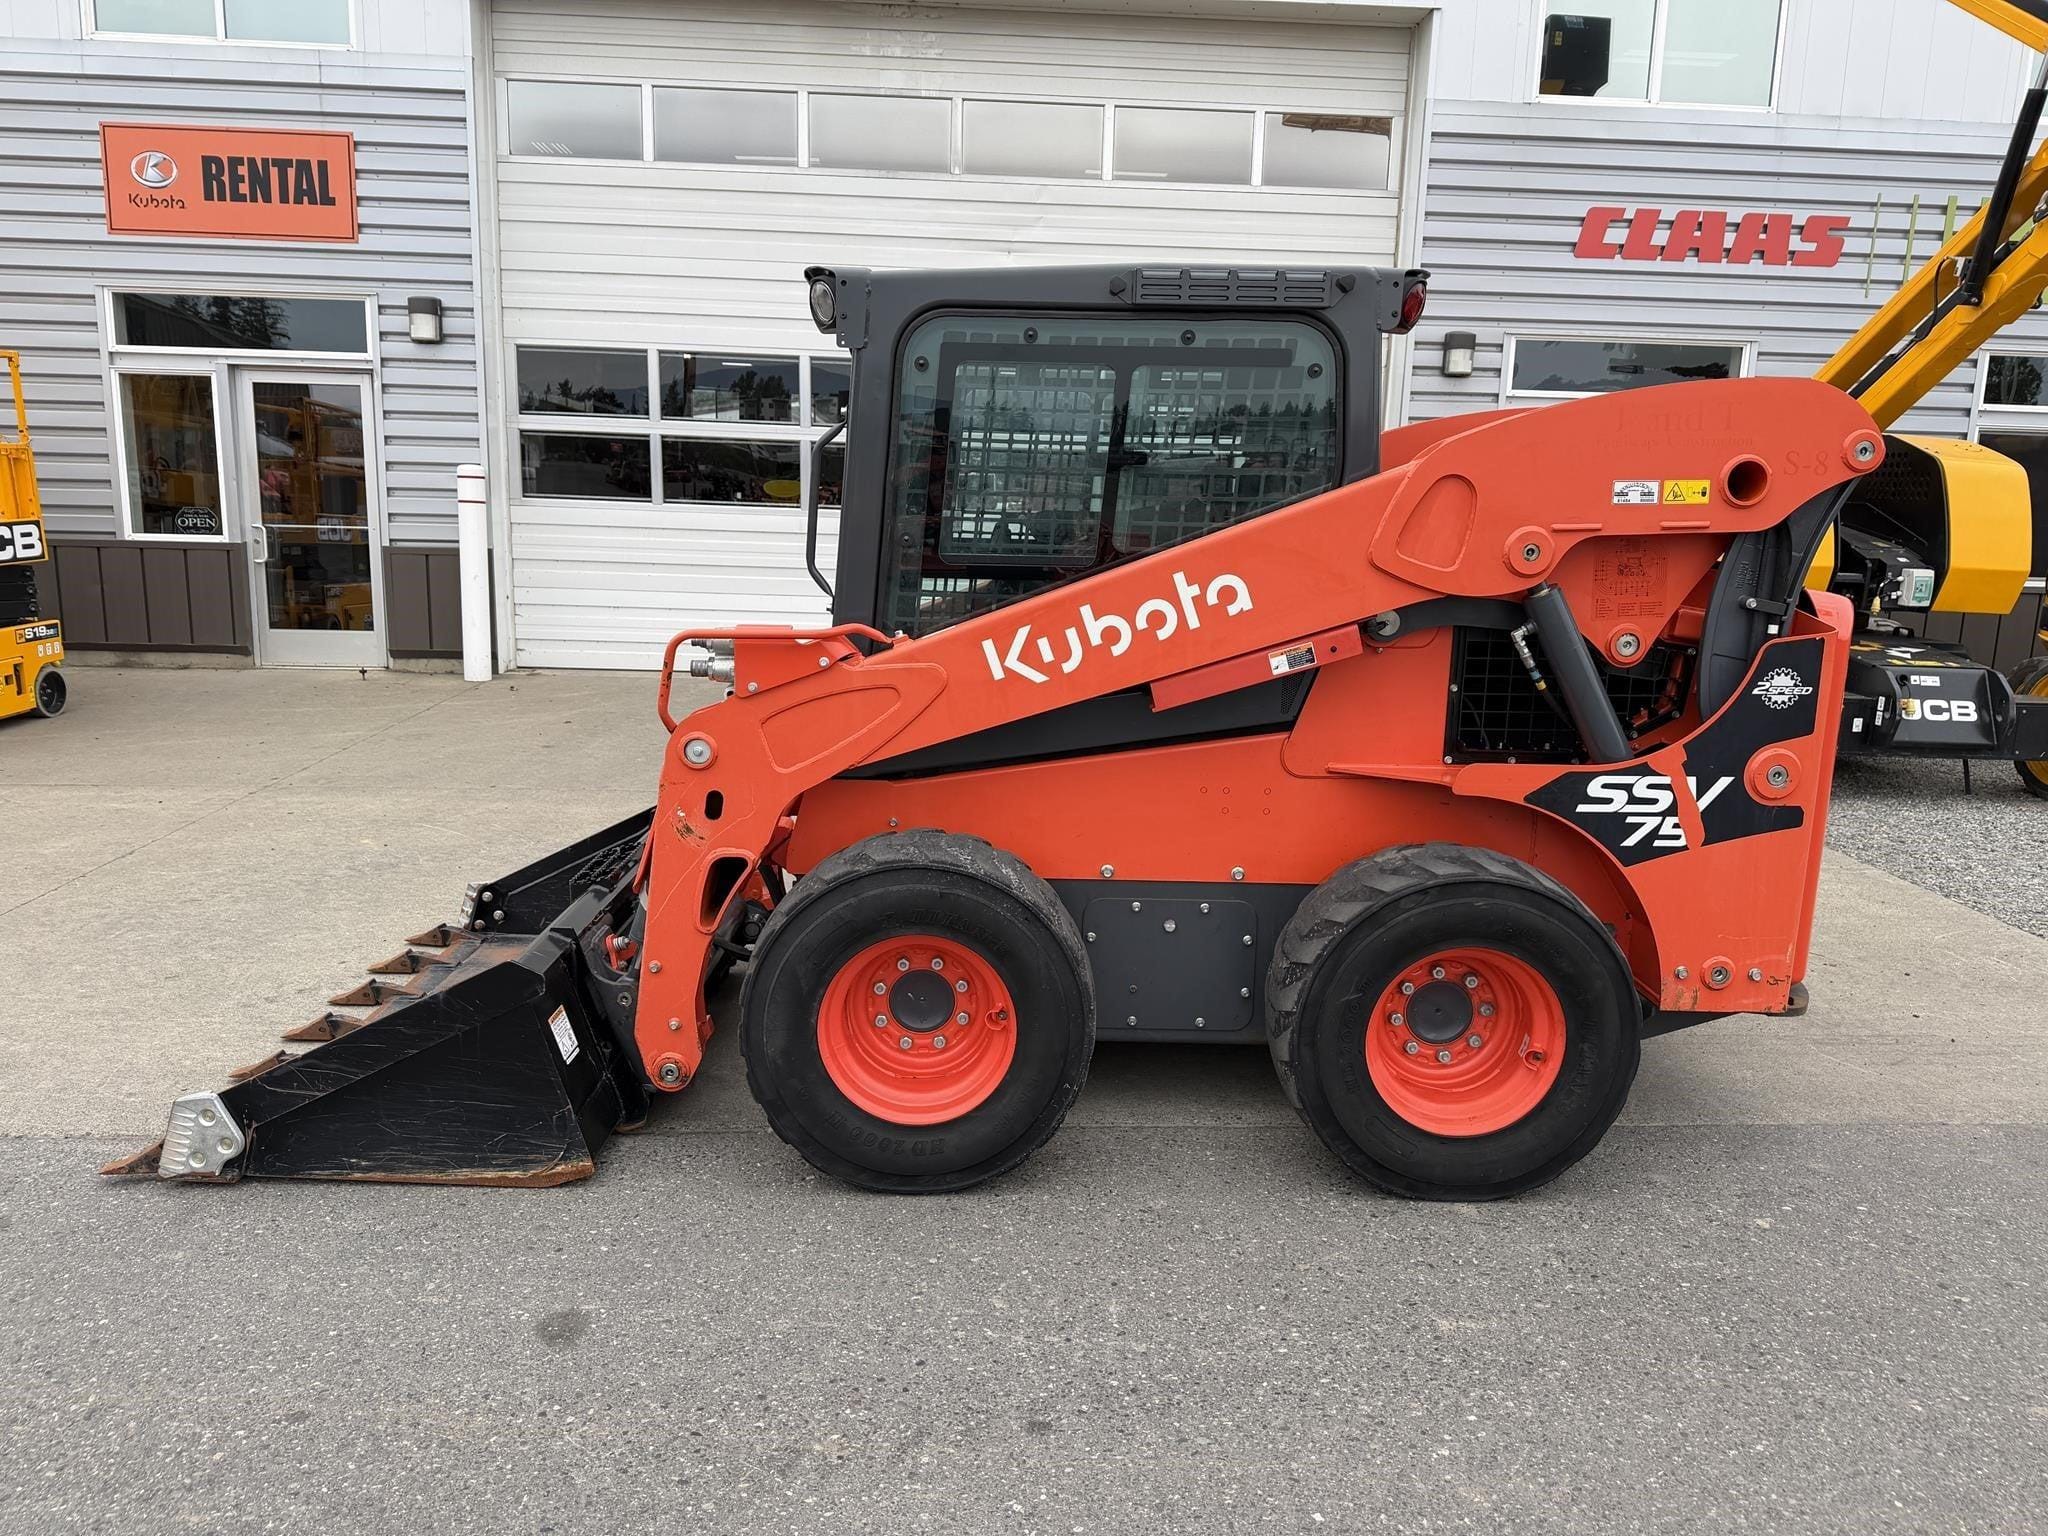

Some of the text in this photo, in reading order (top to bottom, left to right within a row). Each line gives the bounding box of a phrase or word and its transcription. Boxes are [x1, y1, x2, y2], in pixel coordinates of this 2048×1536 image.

[201, 155, 336, 206] RENTAL
[128, 192, 186, 208] Kubota
[1573, 206, 1851, 267] CLAAS
[1783, 450, 1830, 476] S-8
[178, 517, 216, 527] OPEN
[981, 570, 1254, 684] Kubota
[1752, 681, 1813, 696] 2SPEED
[1902, 698, 1978, 722] JCB
[1575, 775, 1736, 813] SSV
[1620, 816, 1689, 847] 75
